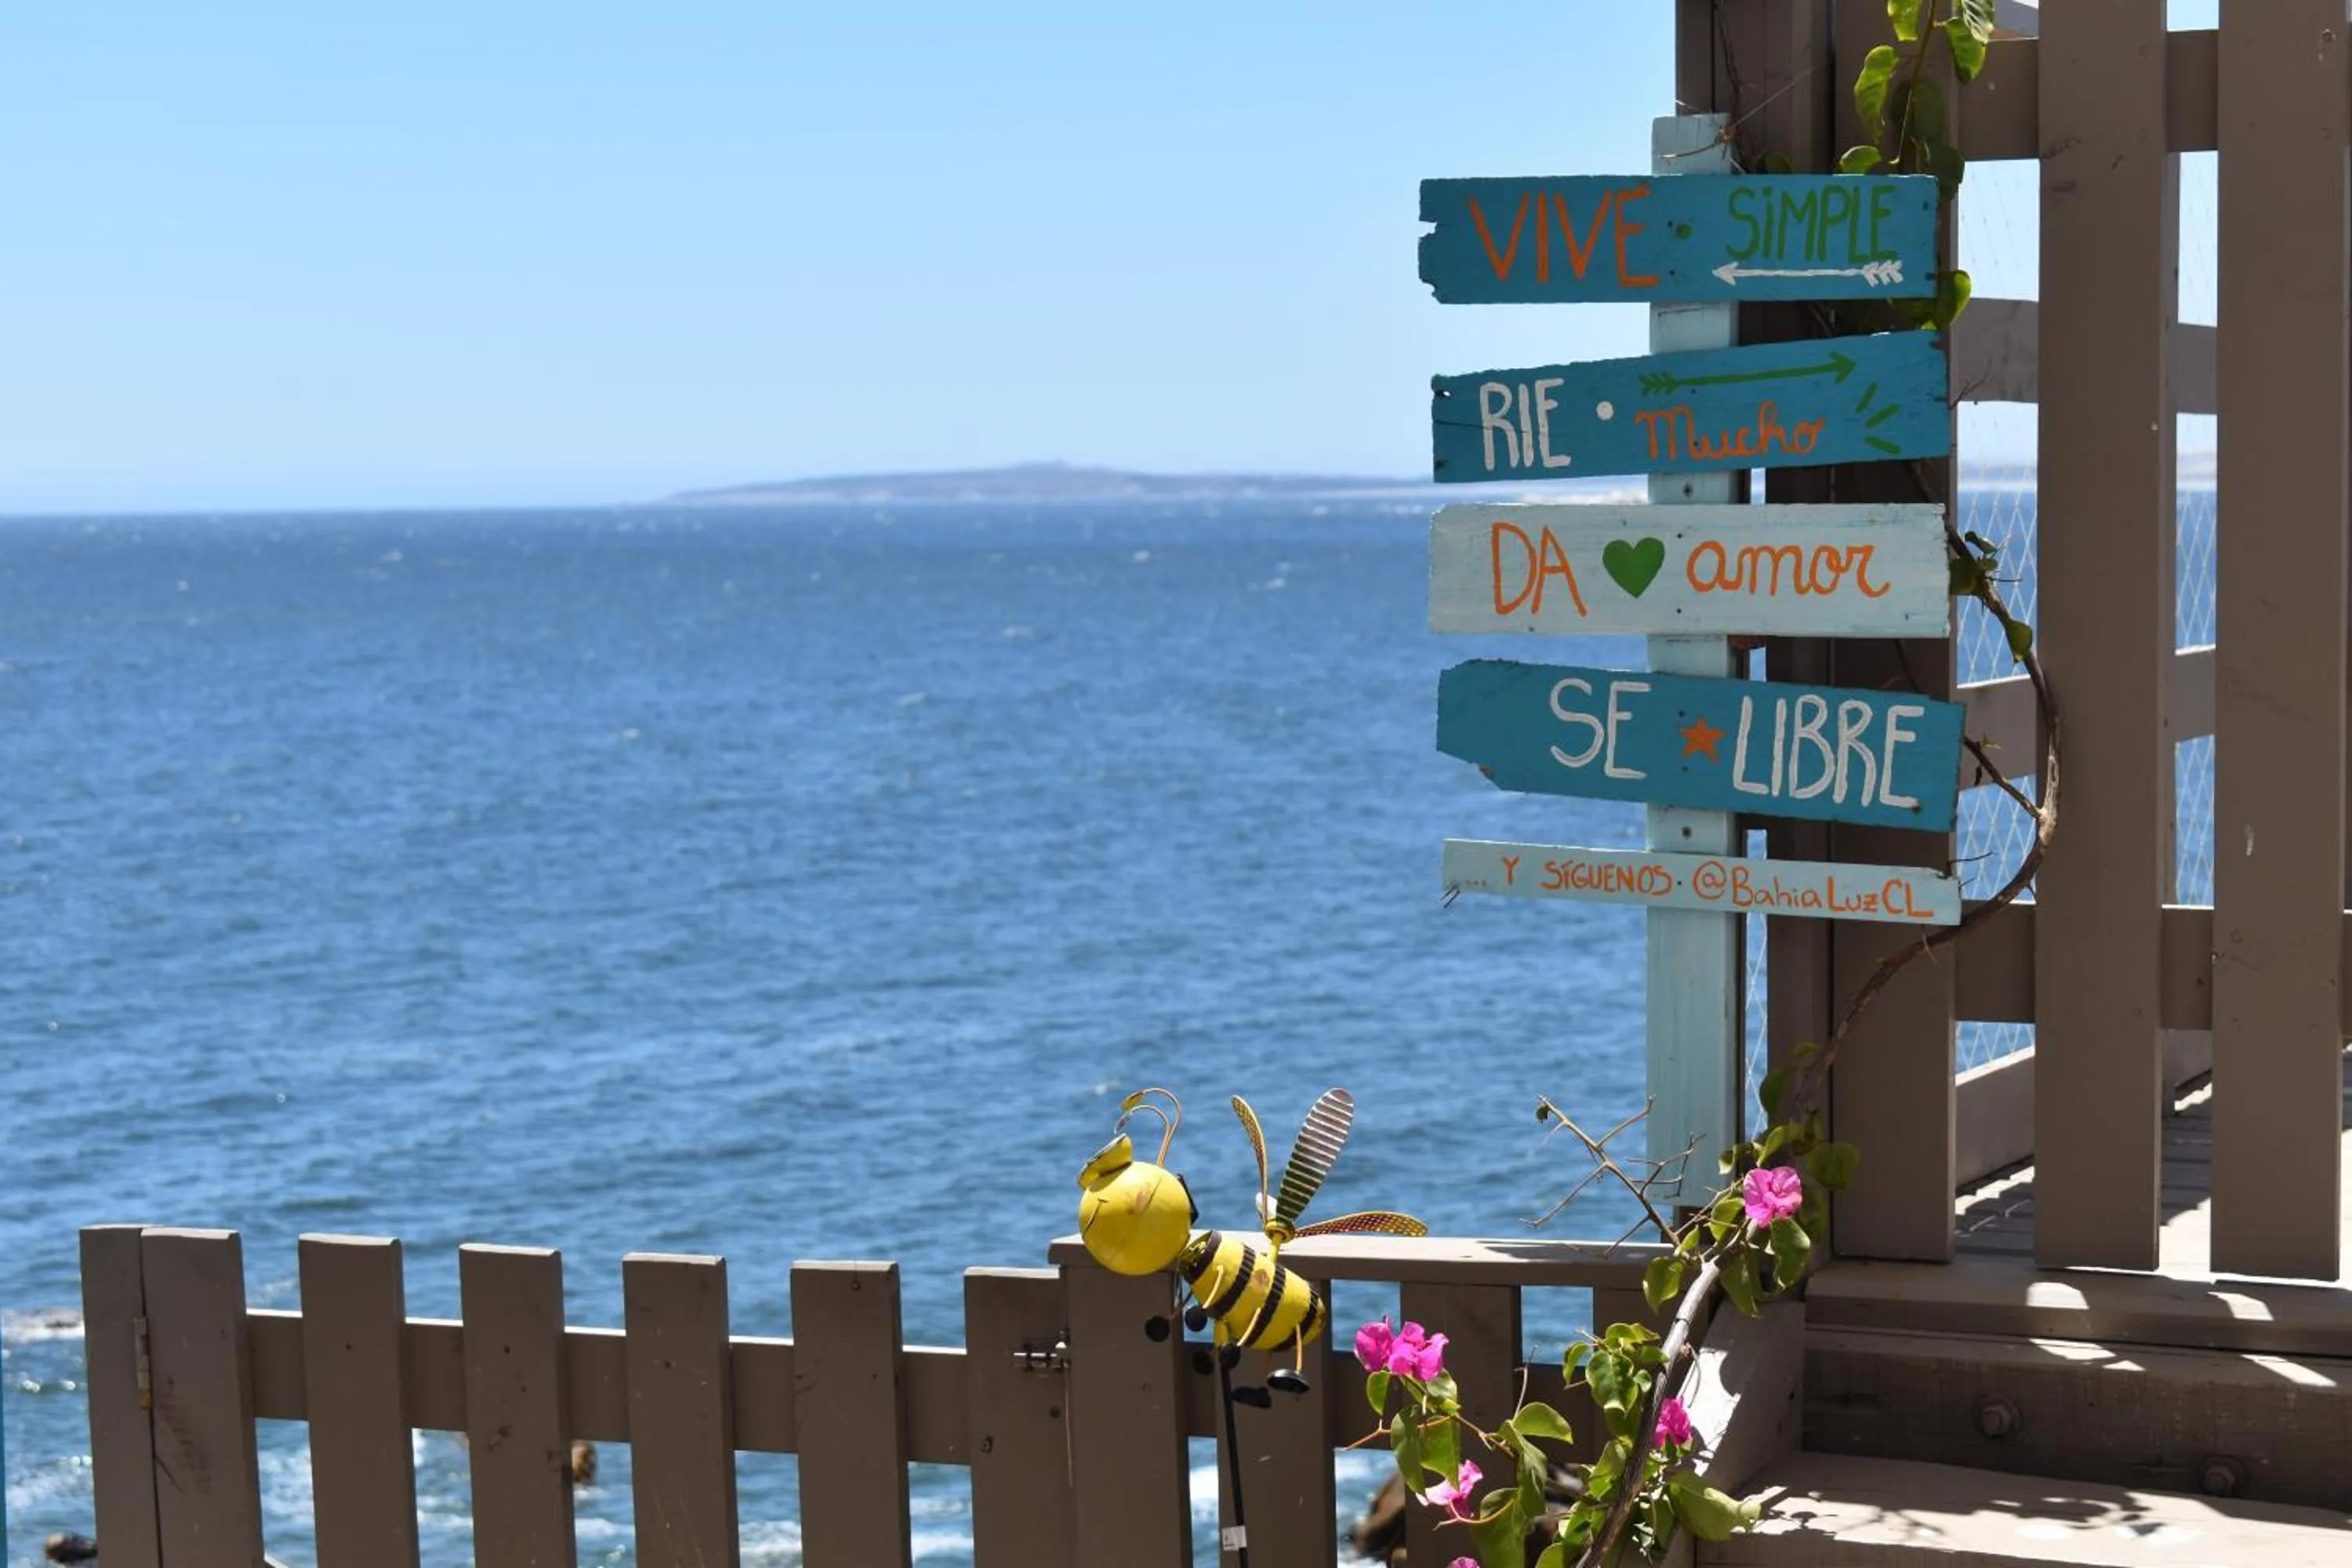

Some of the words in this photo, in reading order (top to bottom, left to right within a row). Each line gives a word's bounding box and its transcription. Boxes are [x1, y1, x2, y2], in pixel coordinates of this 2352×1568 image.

[1468, 185, 1660, 287] VIVE
[1479, 377, 1571, 470] RIE
[1635, 401, 1825, 462] Mucho
[1490, 521, 1588, 616] DA
[1686, 539, 1890, 597] amor
[1550, 677, 1651, 779] SE
[1733, 695, 1926, 808] LIBRE
[1502, 855, 1520, 885] Y
